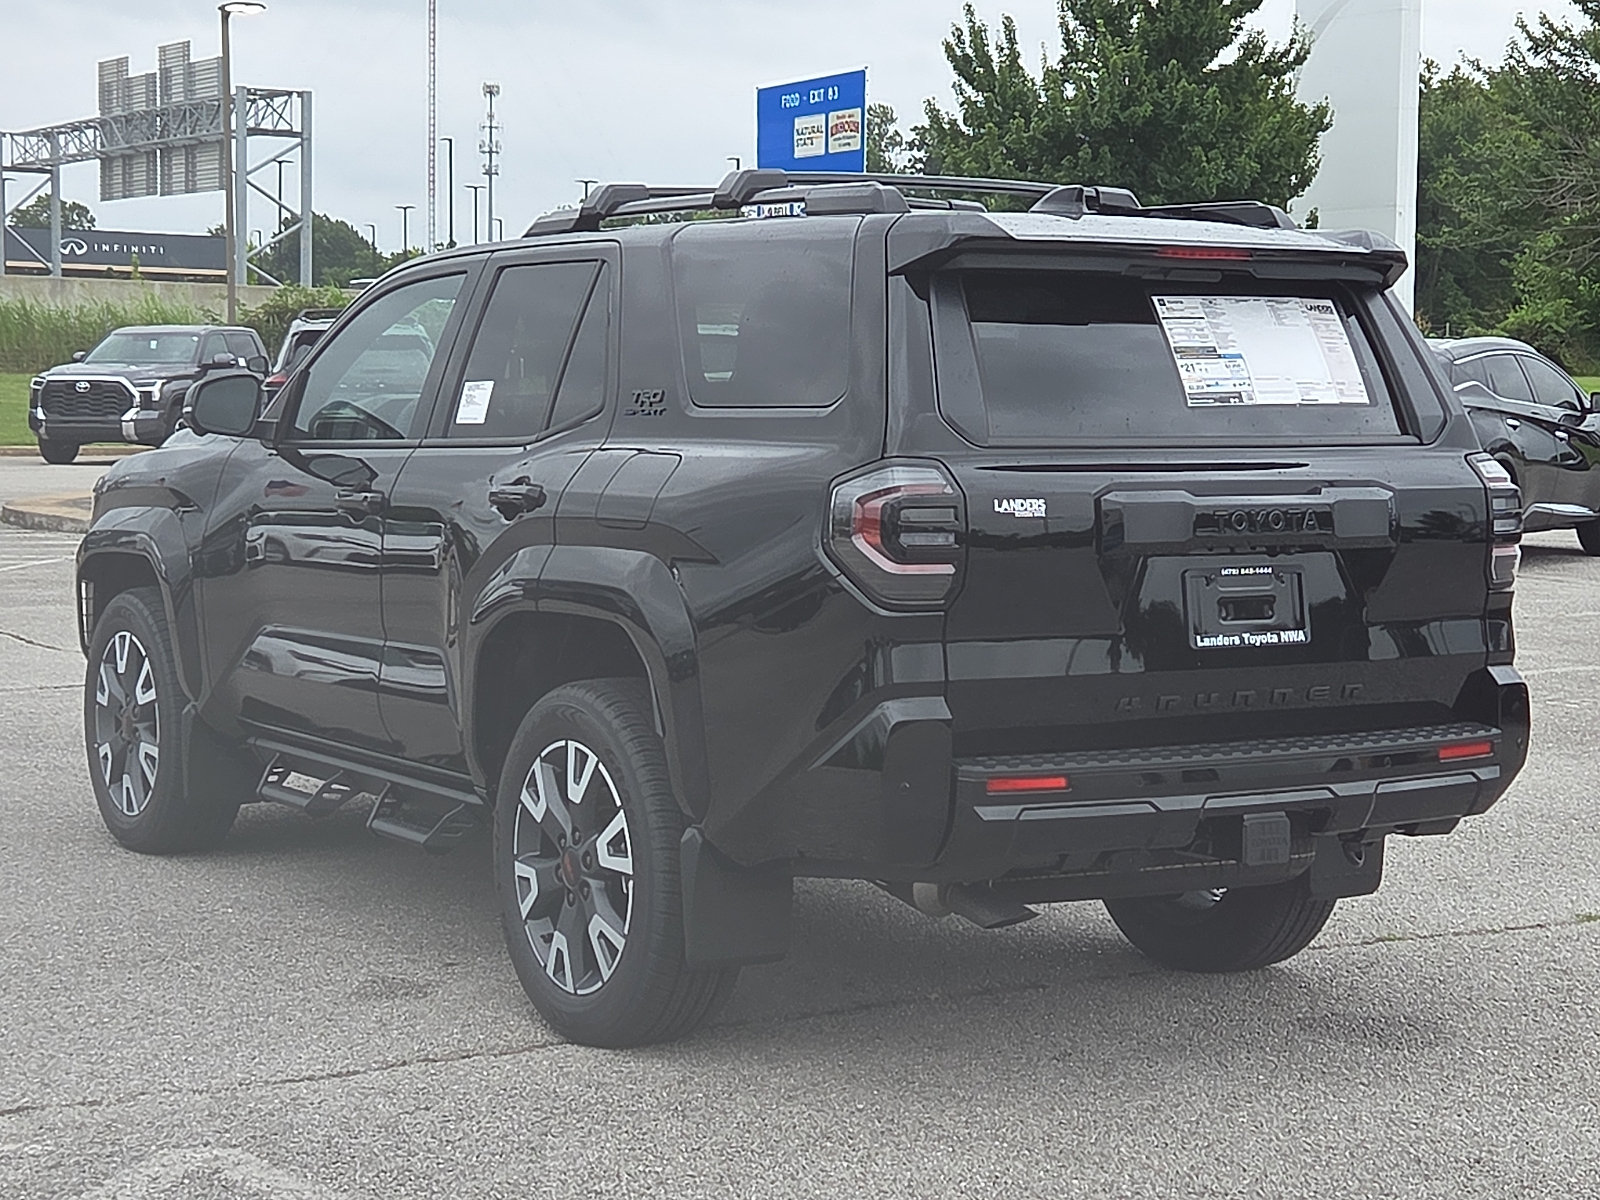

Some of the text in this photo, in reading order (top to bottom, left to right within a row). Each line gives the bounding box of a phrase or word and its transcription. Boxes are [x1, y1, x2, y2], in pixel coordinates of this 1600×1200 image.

[781, 92, 800, 108] FOOD
[809, 88, 825, 104] EXIT
[795, 125, 824, 136] NATURAL
[795, 136, 814, 147] STATE
[94, 243, 164, 255] INFINITI
[632, 390, 665, 407] TRD
[993, 498, 1047, 511] LANDERS
[1213, 507, 1320, 533] TOYOTA
[1196, 630, 1306, 647] Landers Toyota NWA
[1115, 683, 1364, 712] 4RUNNER
